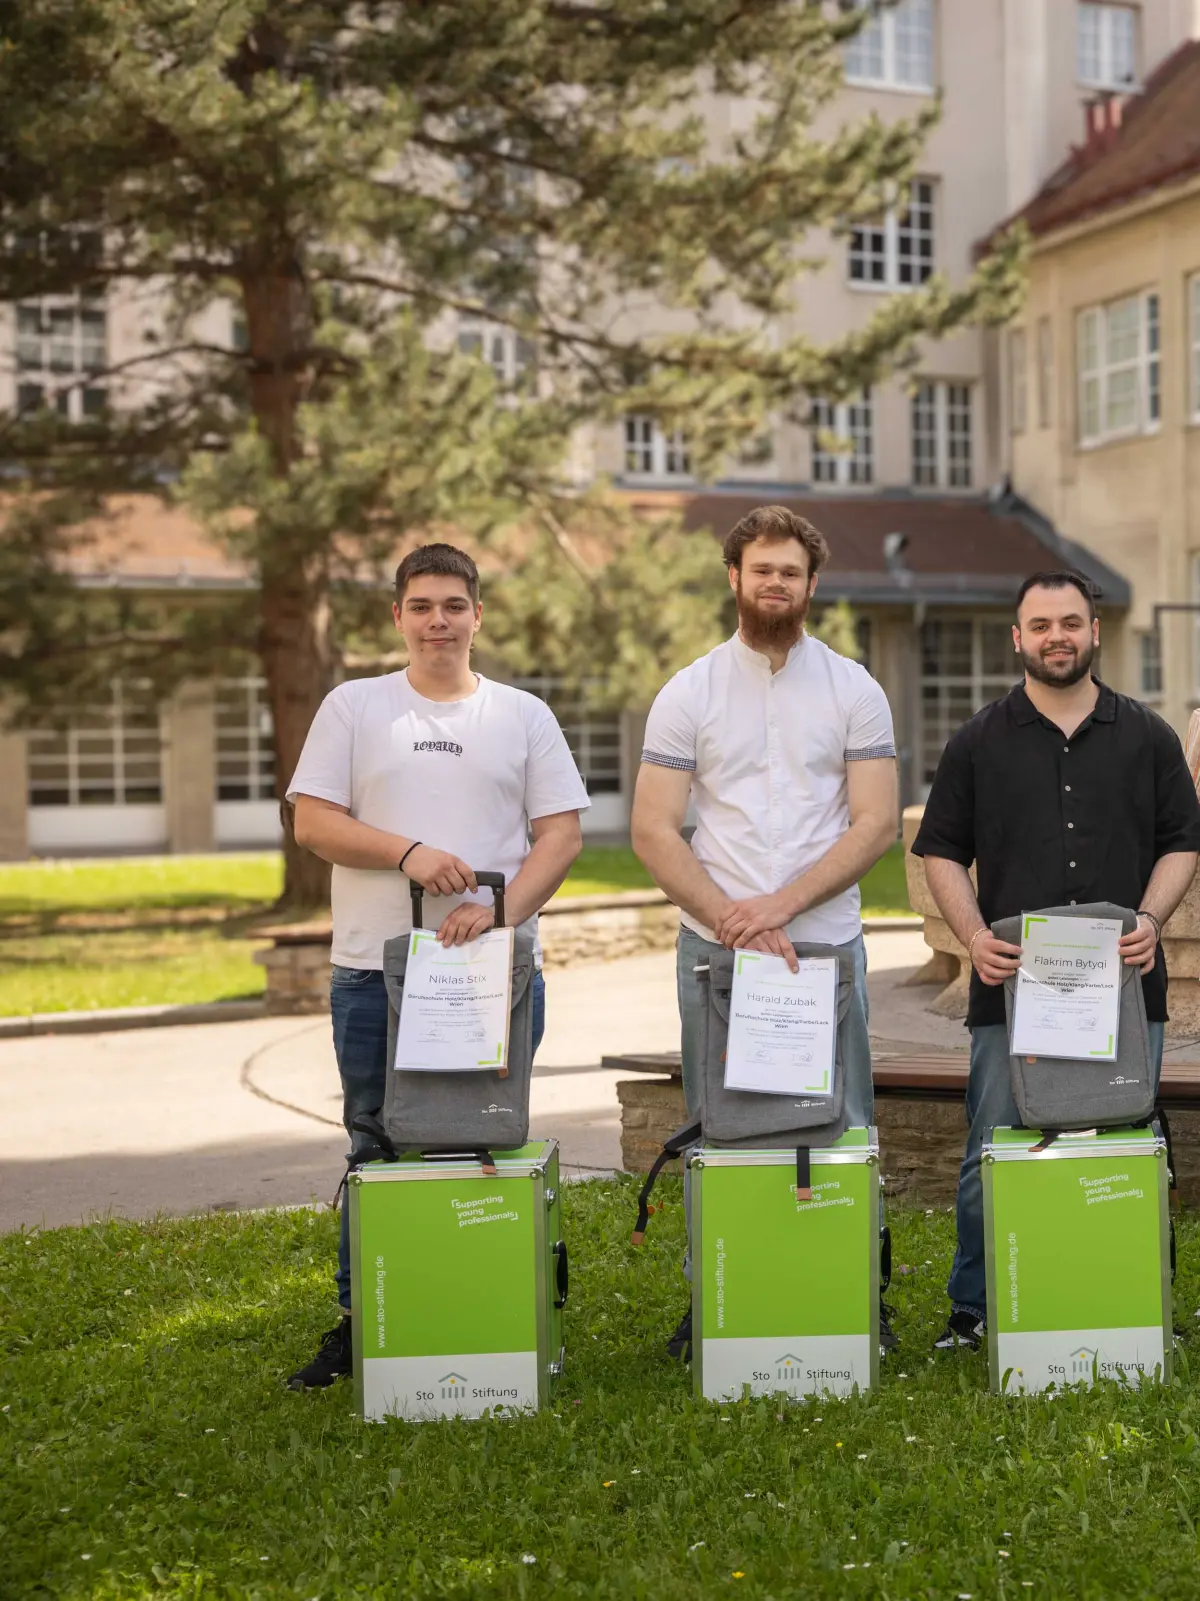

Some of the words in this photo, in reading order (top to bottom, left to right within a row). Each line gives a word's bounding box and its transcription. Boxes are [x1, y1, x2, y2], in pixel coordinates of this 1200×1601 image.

[1034, 956, 1072, 967] Flakrim
[1075, 958, 1107, 970] Bytyqi
[429, 974, 464, 984] Niklas
[467, 974, 487, 983] Stix
[747, 992, 781, 1004] Harald
[784, 997, 817, 1006] Zubak
[1085, 1185, 1111, 1197] young
[1086, 1189, 1140, 1206] professionals
[796, 1197, 851, 1212] professionals
[457, 1207, 484, 1219] young
[458, 1211, 514, 1228] professionals
[716, 1238, 726, 1329] www.sto-stiftung.de
[1008, 1232, 1018, 1323] www.sto-stiftung.de
[375, 1256, 386, 1348] www.sto-stiftung.de
[752, 1370, 770, 1381] Sto
[806, 1368, 850, 1380] Stiftung
[1048, 1364, 1065, 1374] Sto
[1101, 1362, 1145, 1373] Stiftung
[416, 1390, 434, 1401] Sto
[472, 1387, 518, 1400] Stiftung
